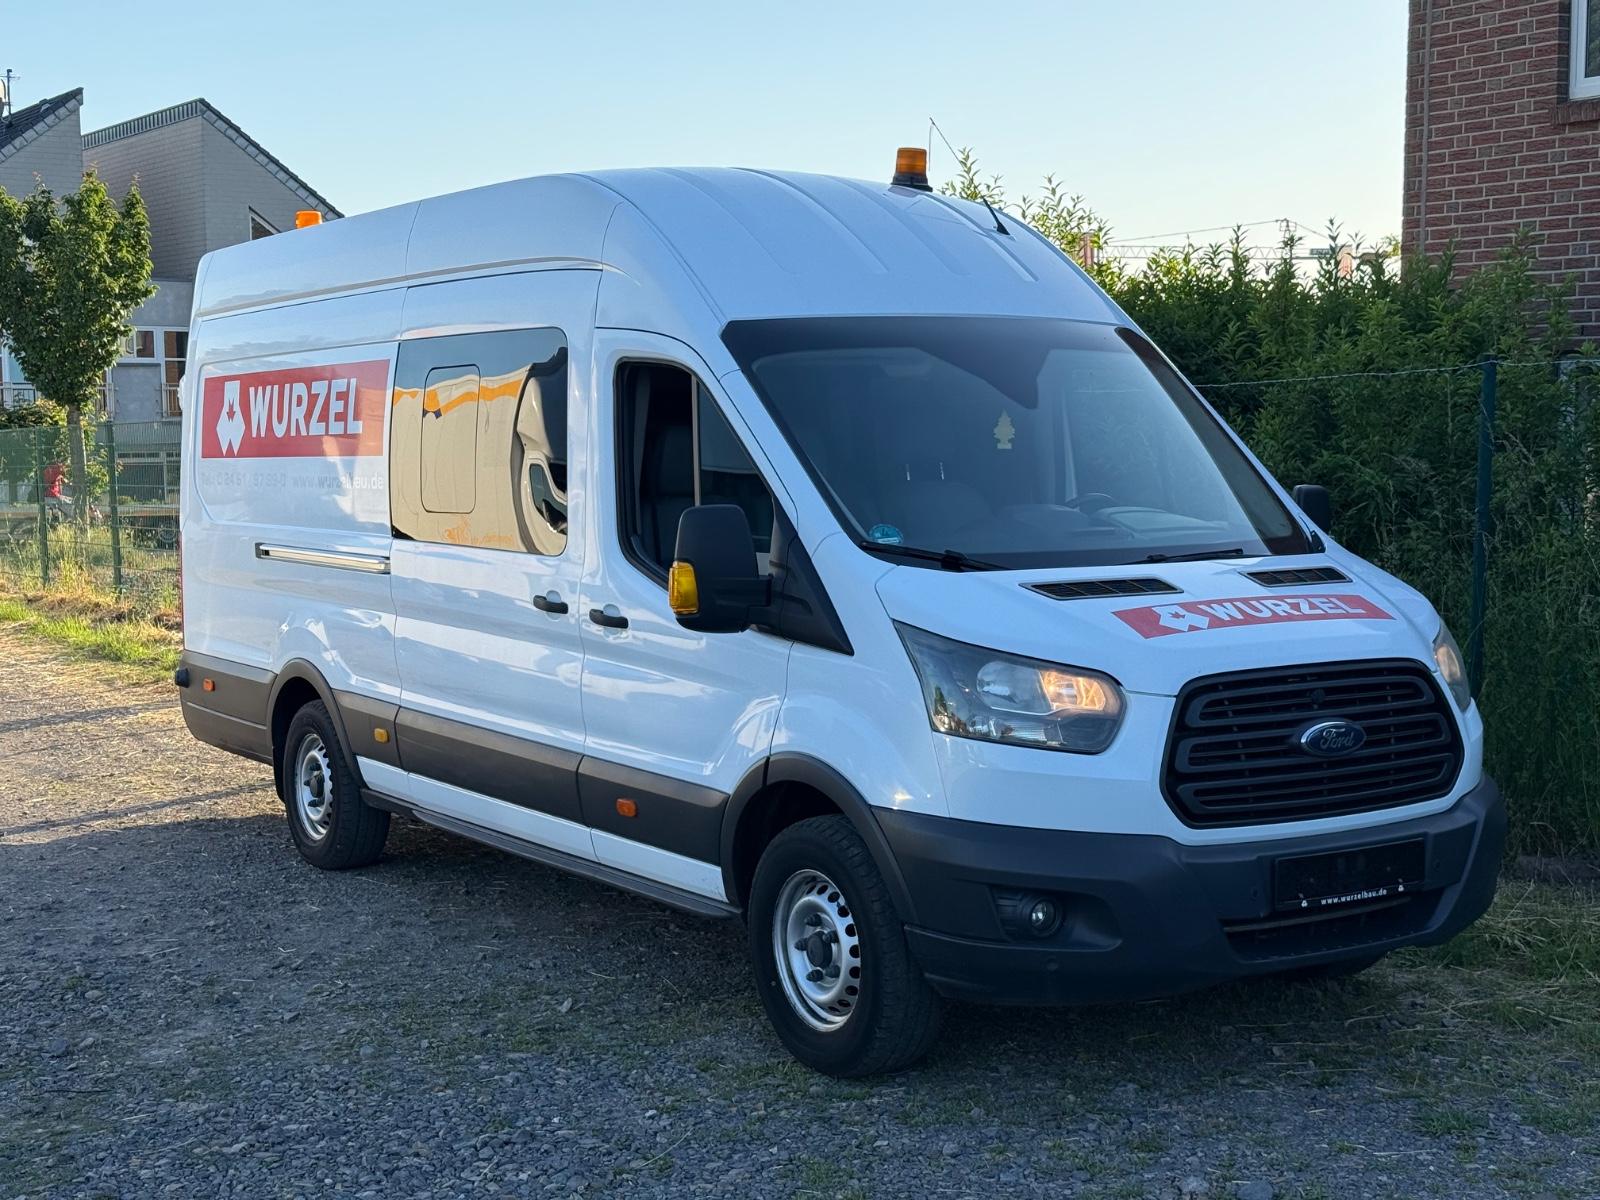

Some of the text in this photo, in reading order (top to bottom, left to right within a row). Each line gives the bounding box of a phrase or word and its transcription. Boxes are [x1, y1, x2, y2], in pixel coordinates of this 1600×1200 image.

[249, 378, 363, 438] WURZEL
[1198, 597, 1366, 621] WURZEL
[1319, 728, 1354, 749] Ford
[1320, 887, 1388, 906] www.wurzelbau.de
